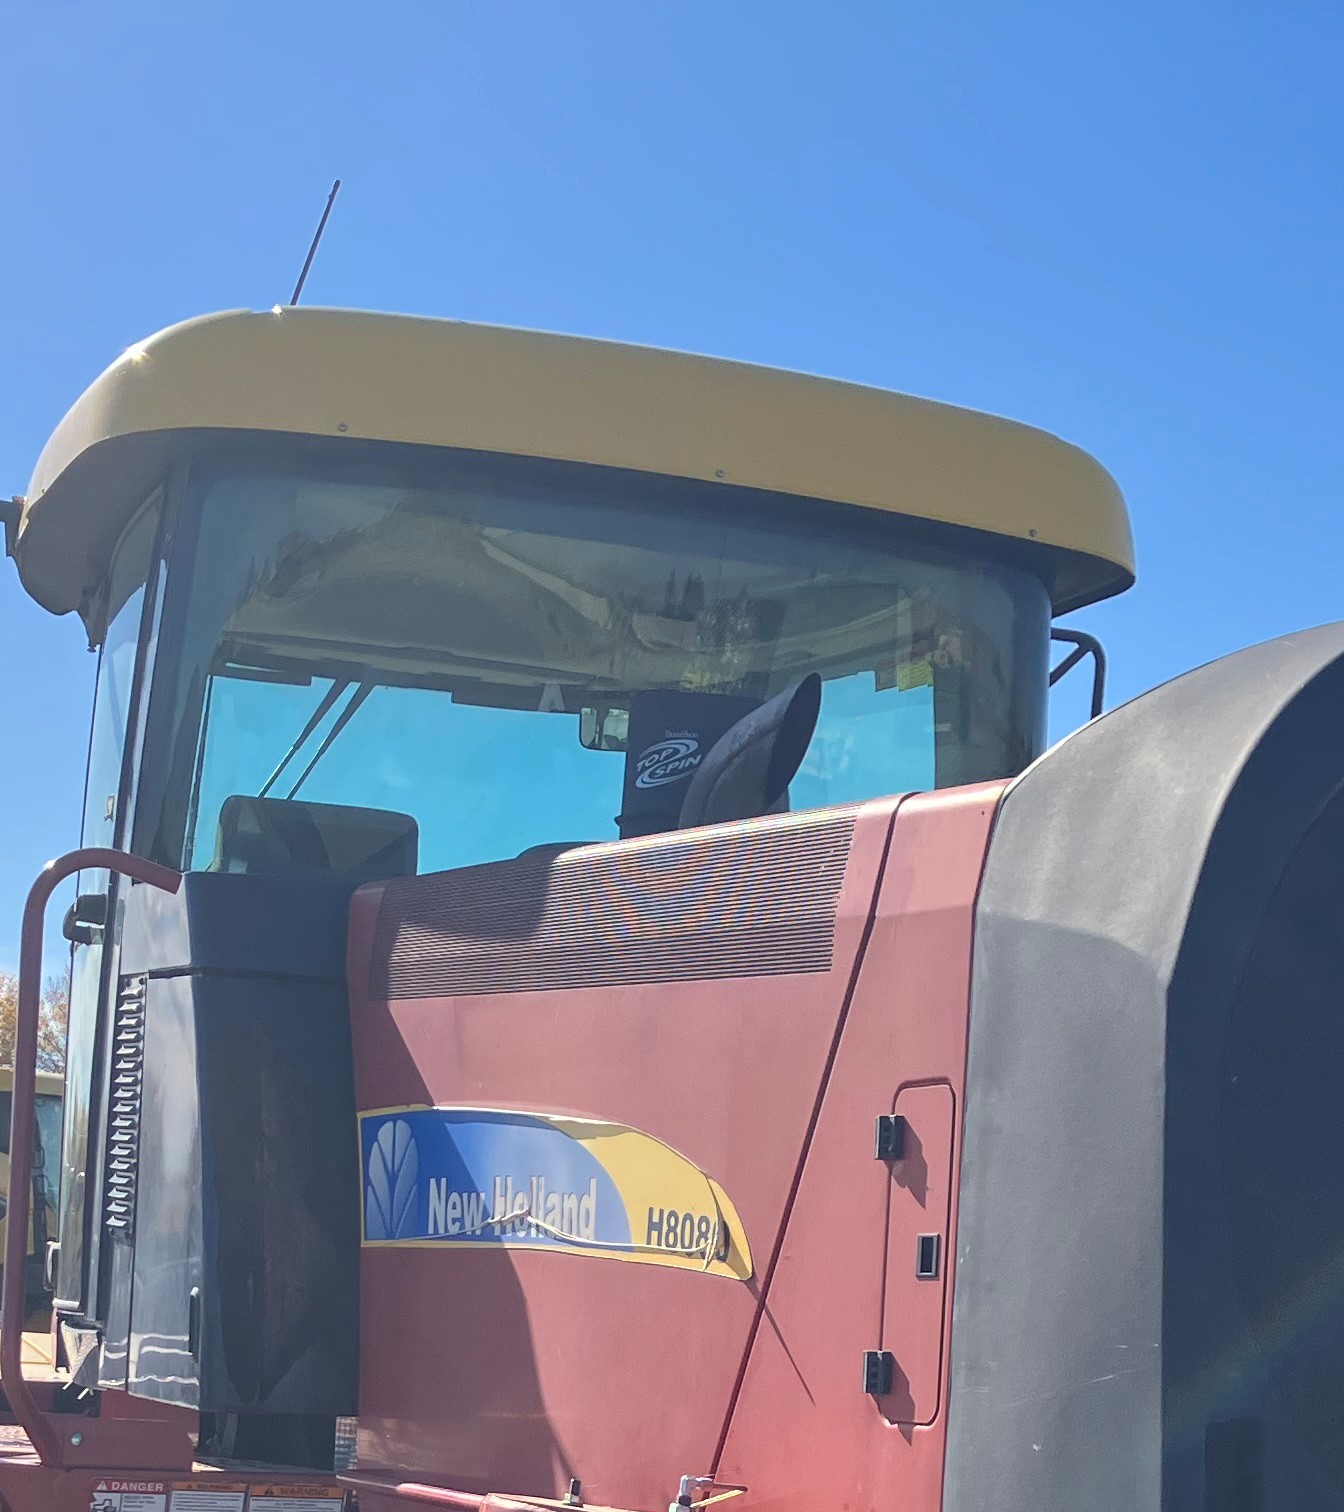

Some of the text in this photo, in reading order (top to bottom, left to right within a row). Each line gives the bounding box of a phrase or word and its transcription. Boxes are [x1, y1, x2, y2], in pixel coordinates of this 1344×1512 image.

[637, 749, 673, 772] TOP
[654, 754, 702, 778] SPIN
[428, 1175, 597, 1241] New Holland
[111, 1481, 164, 1492] DANGER
